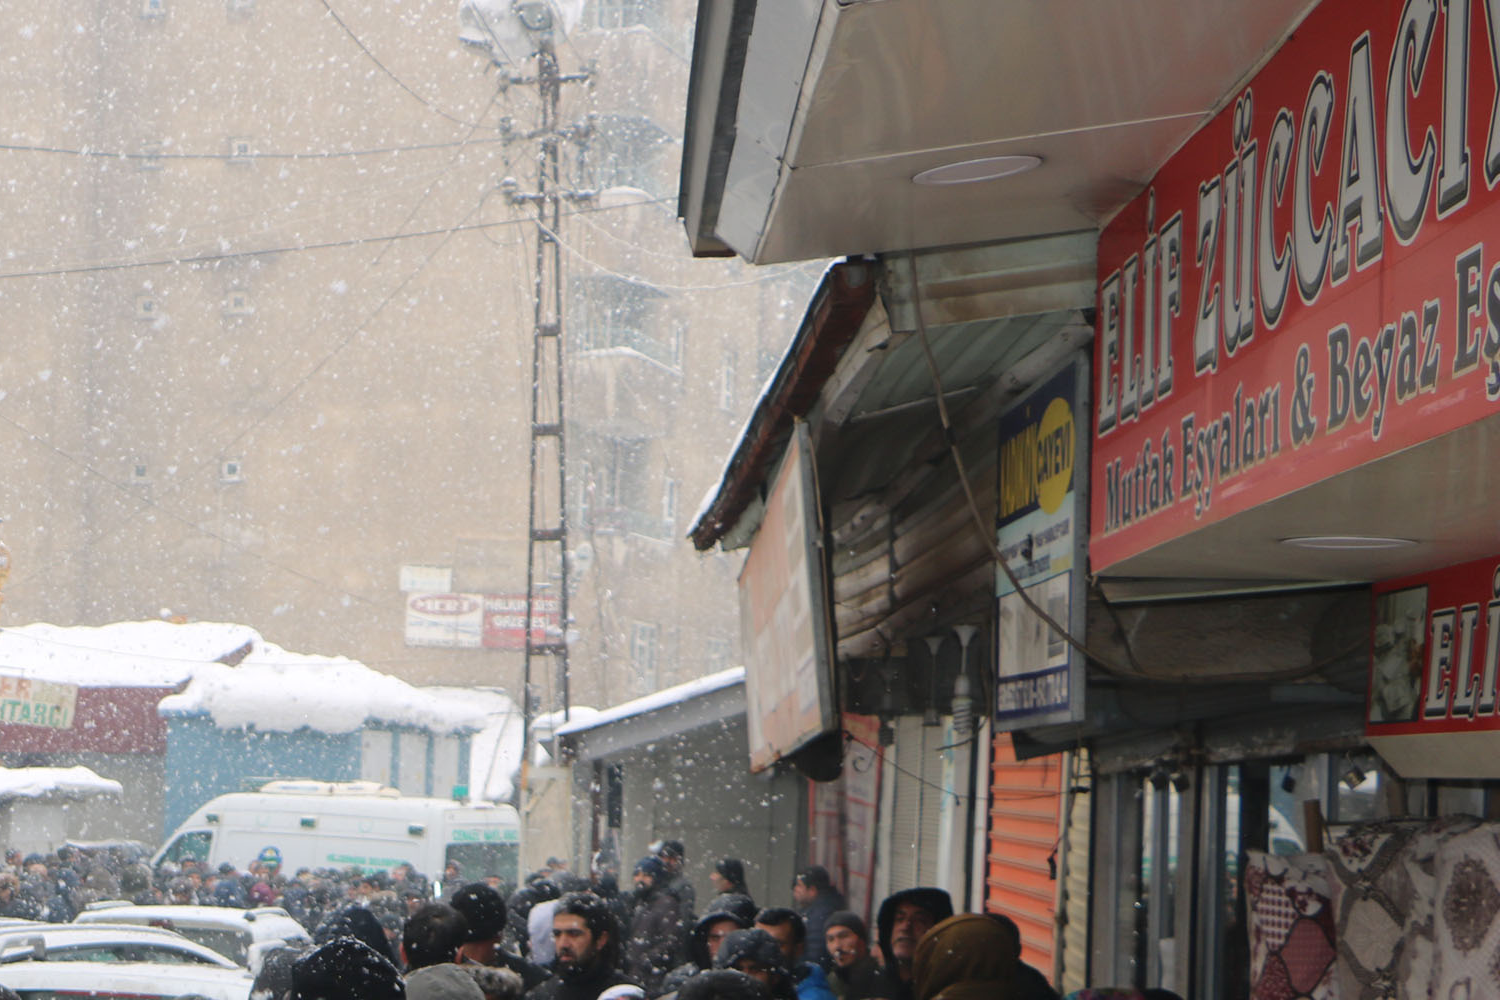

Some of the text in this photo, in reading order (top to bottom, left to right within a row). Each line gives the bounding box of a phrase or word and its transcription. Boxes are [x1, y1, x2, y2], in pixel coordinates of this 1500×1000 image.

[1098, 186, 1183, 438] ELİF
[1103, 426, 1175, 537] Mutfak
[1180, 380, 1282, 520] Eşyaları
[1290, 343, 1317, 451] &
[1326, 297, 1441, 442] Beyaz
[1423, 564, 1500, 722] ELİ
